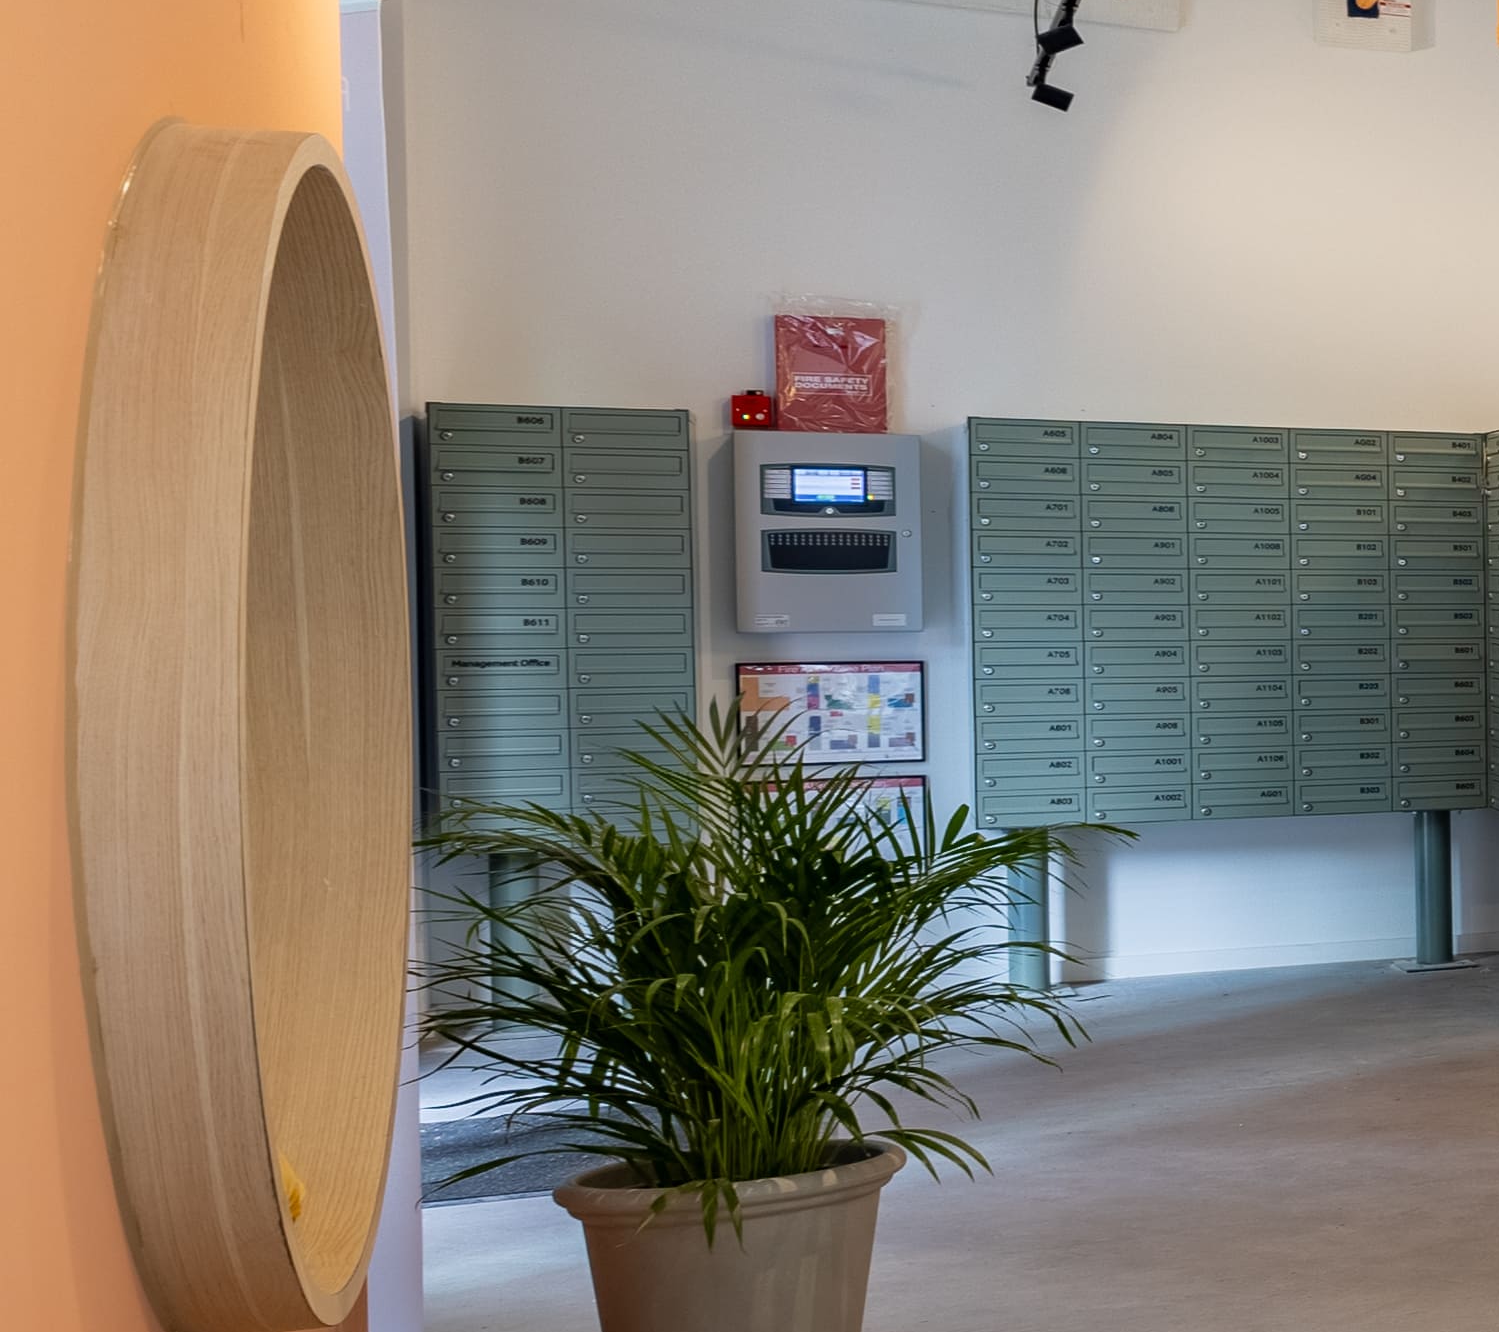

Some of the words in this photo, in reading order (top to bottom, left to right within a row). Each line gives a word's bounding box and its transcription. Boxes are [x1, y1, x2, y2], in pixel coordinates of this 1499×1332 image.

[794, 375, 821, 383] FIRE
[823, 376, 869, 384] SAFETY
[794, 382, 868, 391] DOCUMENTS
[451, 659, 519, 669] Management
[520, 658, 551, 667] Office
